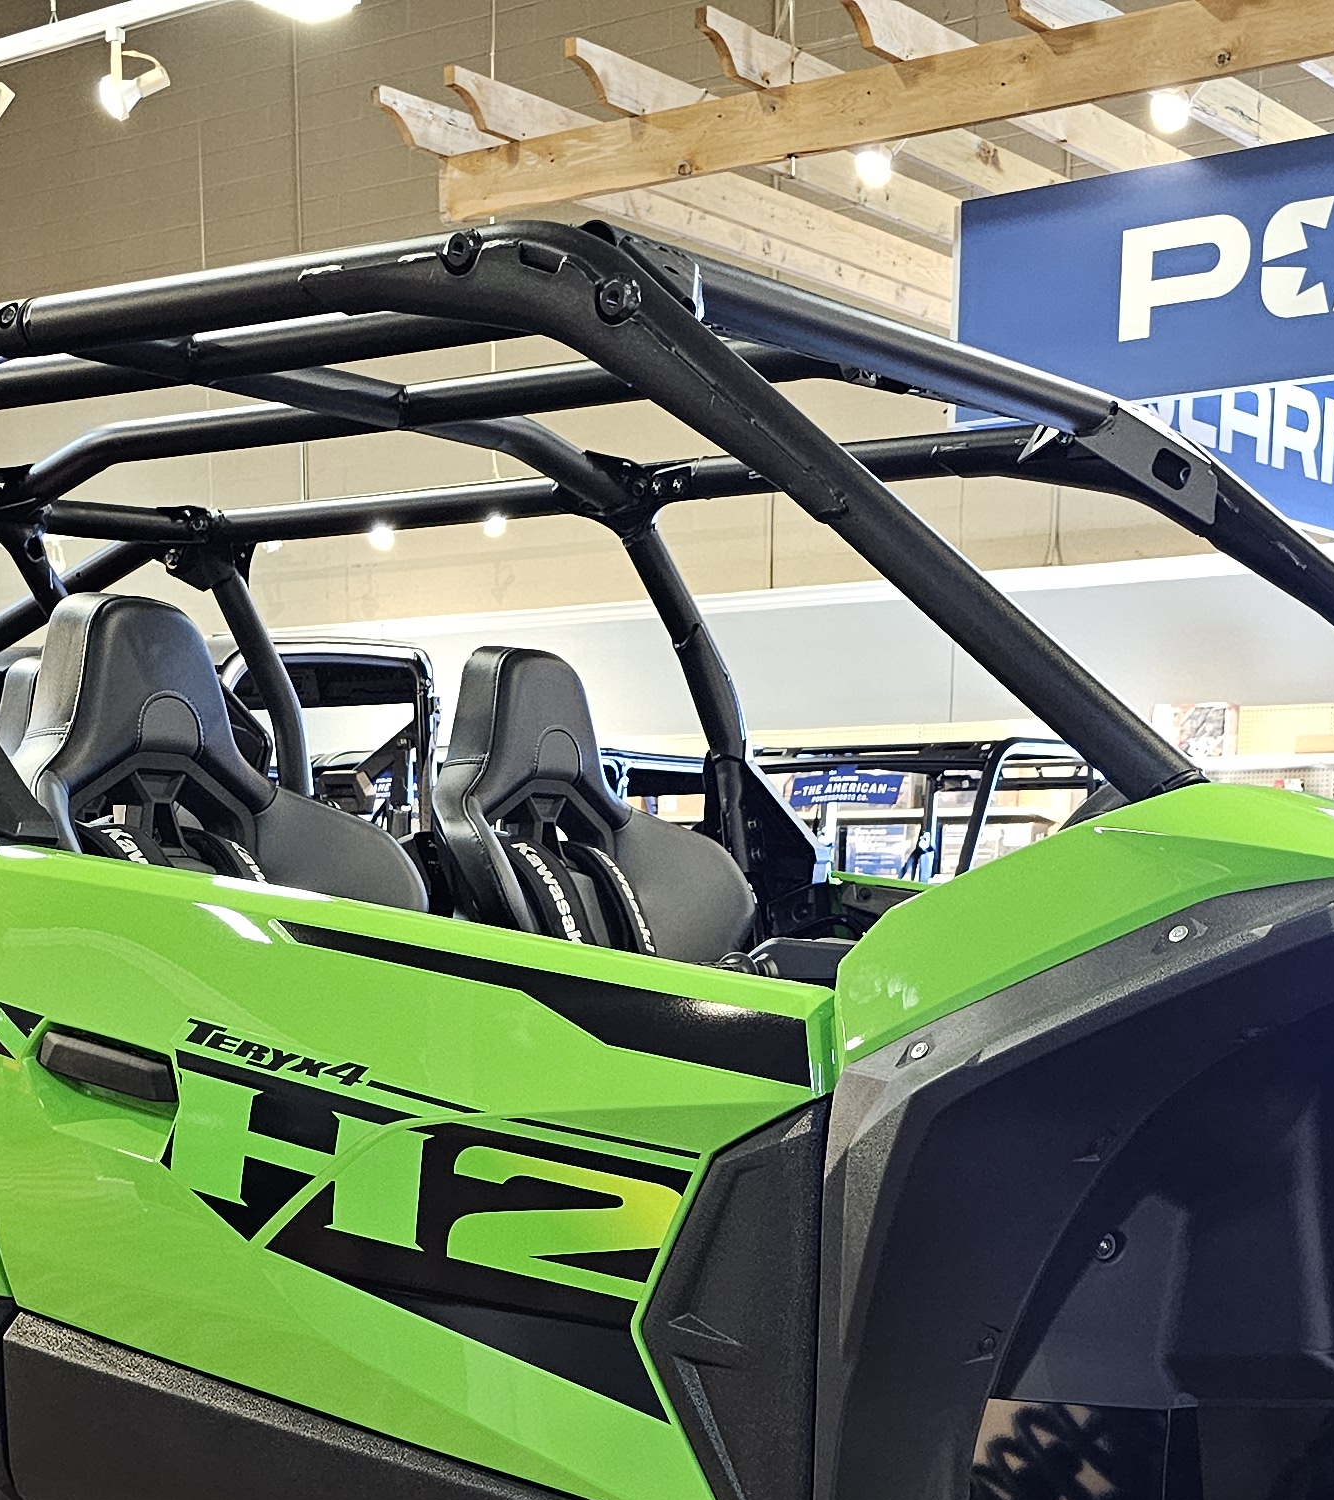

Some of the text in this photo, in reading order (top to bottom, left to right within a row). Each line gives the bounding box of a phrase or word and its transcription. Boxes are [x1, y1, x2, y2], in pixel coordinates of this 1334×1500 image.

[802, 782, 888, 797] THE AMERICAN
[169, 1068, 685, 1302] H2
